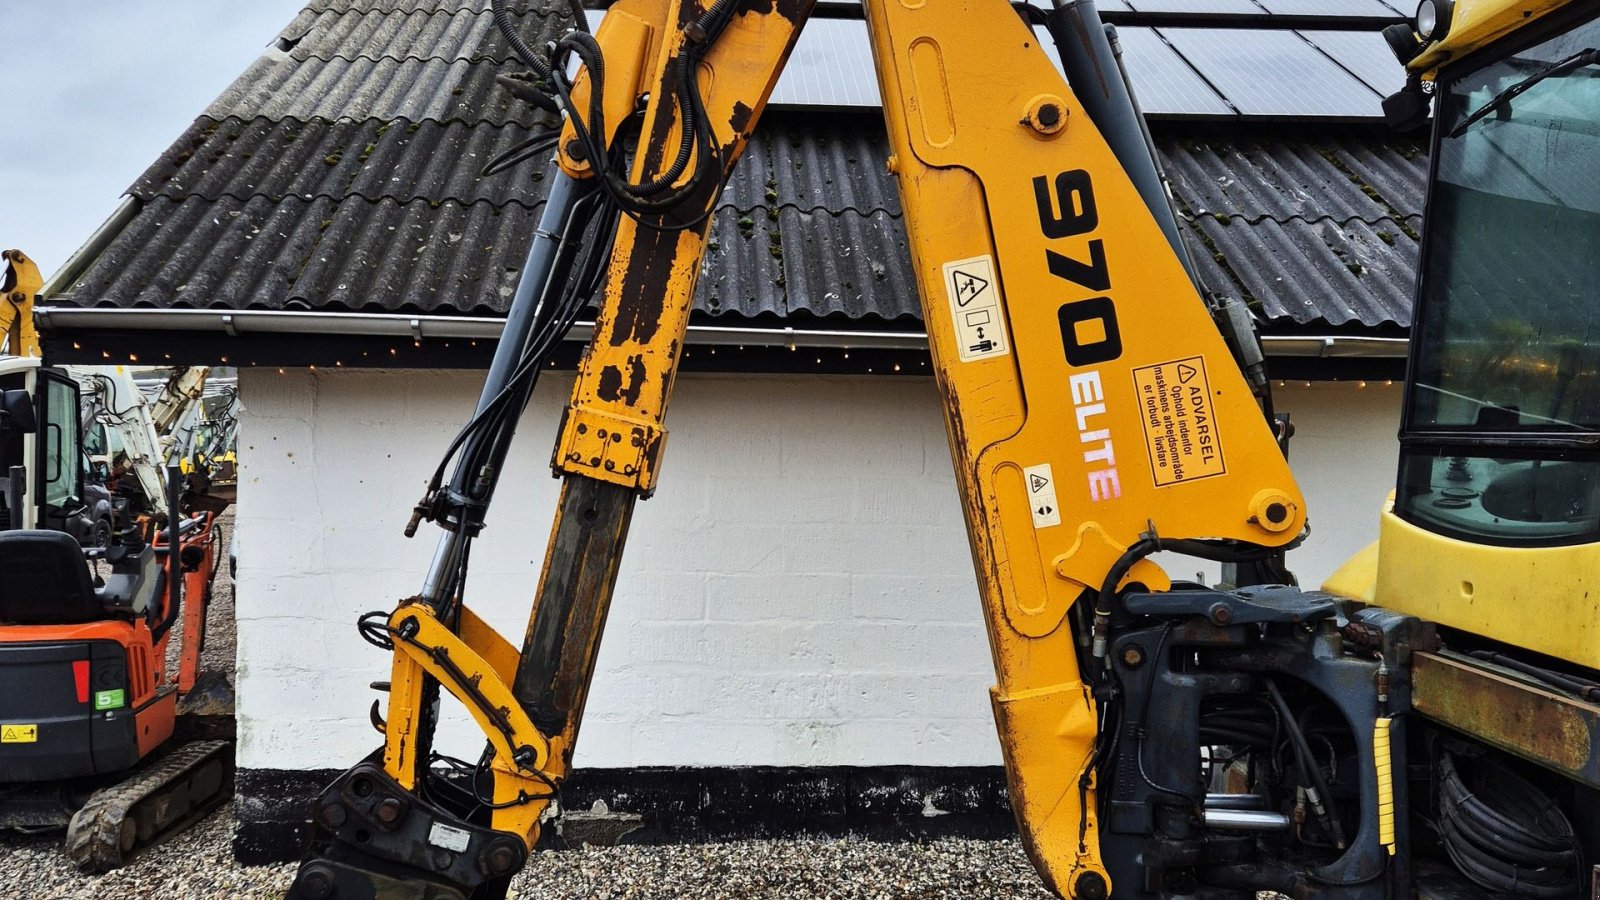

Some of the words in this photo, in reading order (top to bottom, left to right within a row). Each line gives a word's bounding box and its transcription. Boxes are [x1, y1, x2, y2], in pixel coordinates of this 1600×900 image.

[1032, 168, 1123, 368] 970
[1143, 384, 1153, 394] er
[1171, 385, 1187, 418] Ophold
[1146, 396, 1162, 428] forbudt
[1154, 366, 1170, 413] maskinens
[1163, 415, 1184, 480] arbejdsområde
[1189, 386, 1214, 465] ADVARSEL
[1069, 370, 1121, 502] ELITE
[1154, 436, 1168, 468] livsfare
[1178, 419, 1194, 456] indenfor
[98, 691, 112, 706] 5
